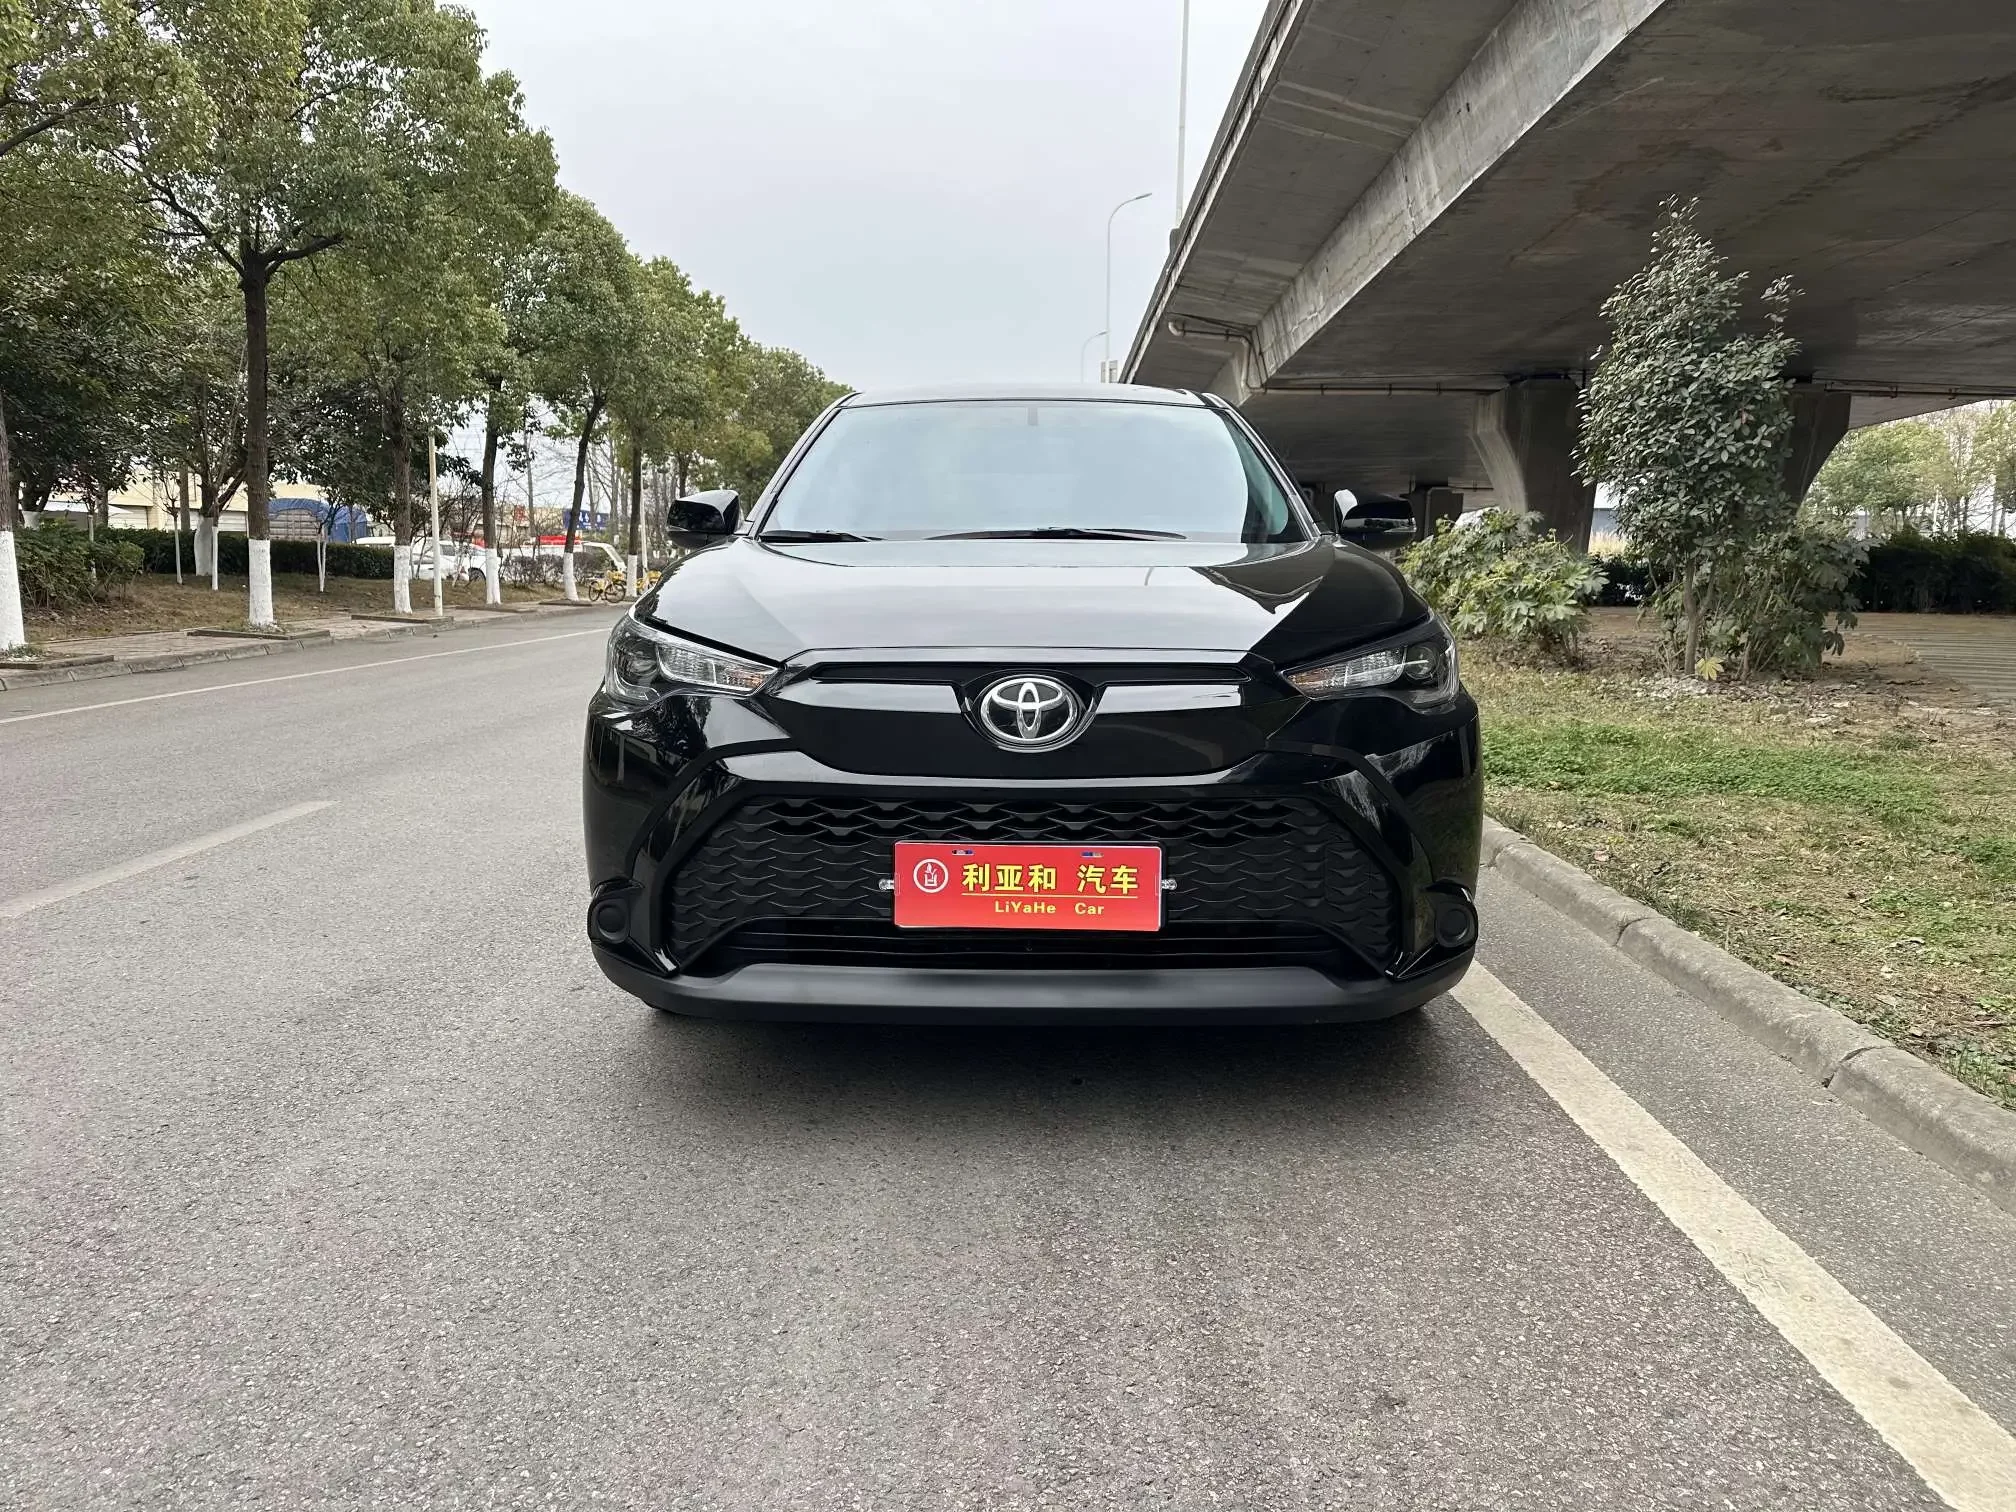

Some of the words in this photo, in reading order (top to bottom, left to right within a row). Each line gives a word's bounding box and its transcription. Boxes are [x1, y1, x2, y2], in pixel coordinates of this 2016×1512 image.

[962, 863, 1057, 893] 利亚和
[1076, 864, 1139, 894] 汽车
[995, 900, 1057, 914] LiYaHe
[1074, 902, 1105, 915] Car
